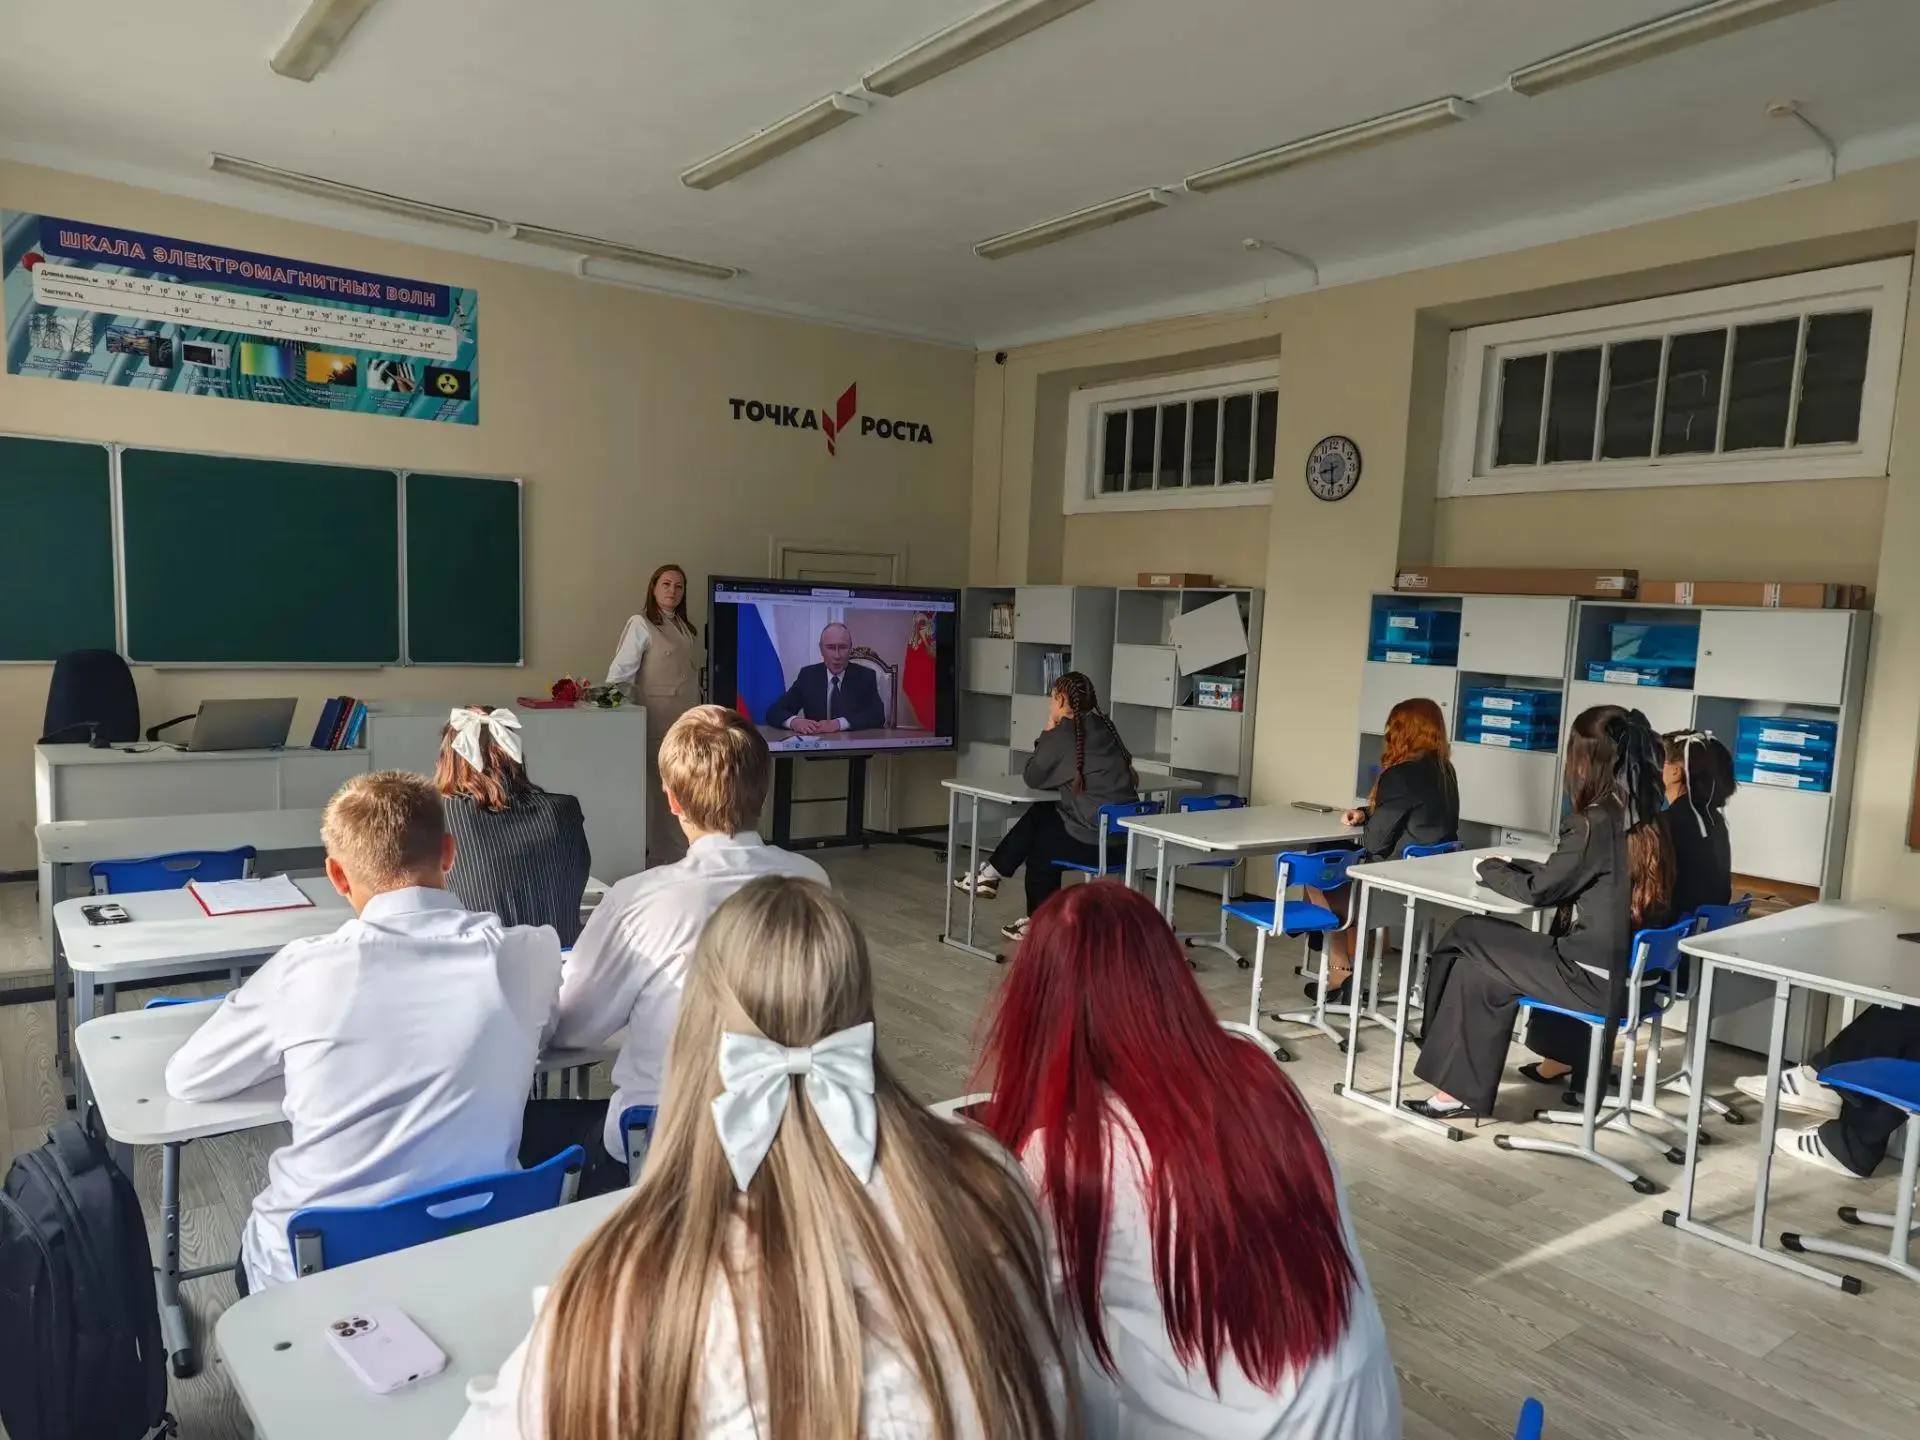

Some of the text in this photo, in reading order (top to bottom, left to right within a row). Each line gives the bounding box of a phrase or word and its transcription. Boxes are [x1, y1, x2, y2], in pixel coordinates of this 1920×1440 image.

[59, 230, 436, 308] ШКАЛА ЭЛЕКТРОМАГНИТНЫХ ВОЛН
[729, 398, 933, 444] ТОЧКА РОСТА
